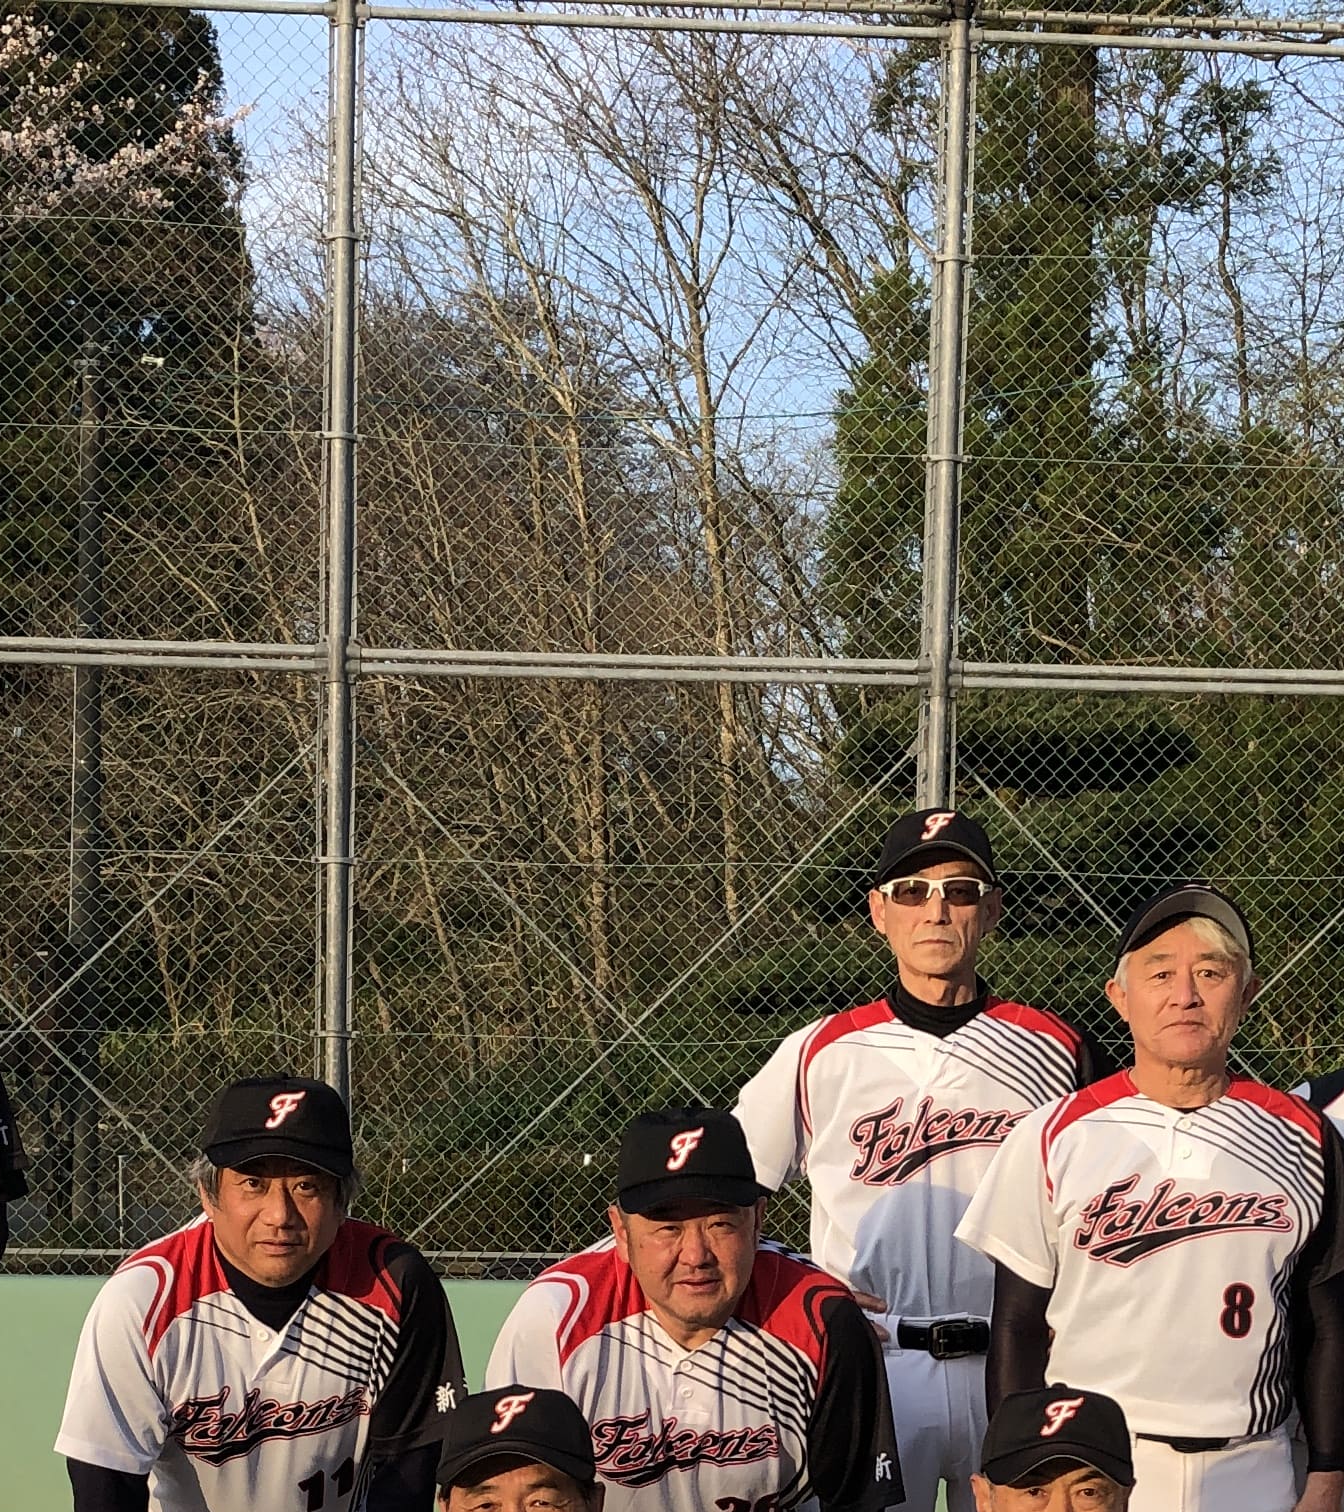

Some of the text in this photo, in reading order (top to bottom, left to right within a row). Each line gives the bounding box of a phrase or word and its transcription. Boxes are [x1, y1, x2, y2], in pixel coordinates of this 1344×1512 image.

[920, 812, 955, 841] F
[264, 1090, 306, 1130] F
[666, 1127, 704, 1171] F
[1074, 1173, 1294, 1268] Falcons
[1220, 1282, 1255, 1338] 8
[168, 1385, 369, 1467] Falcons
[489, 1392, 534, 1434] F
[1039, 1397, 1084, 1436] F
[590, 1408, 778, 1489] Falcons
[297, 1456, 355, 1512] 11
